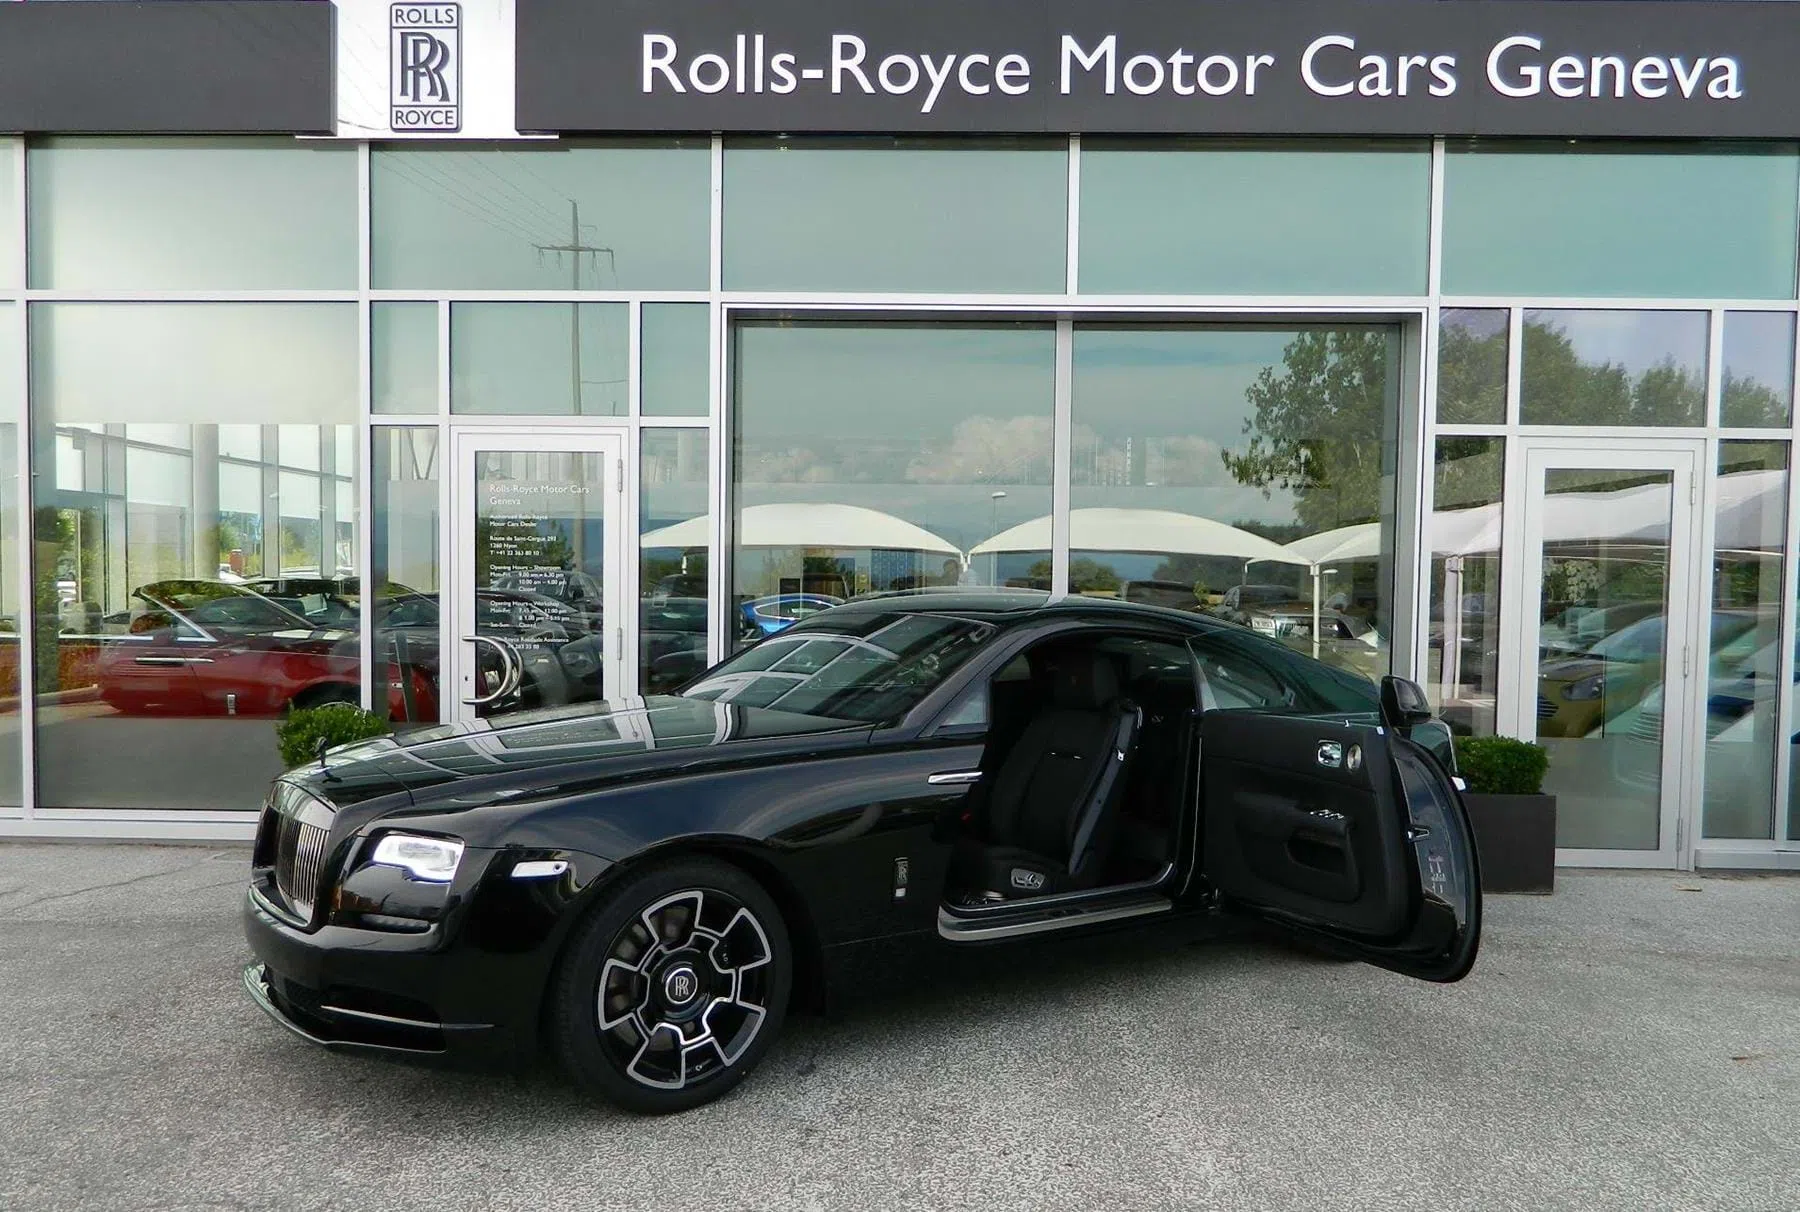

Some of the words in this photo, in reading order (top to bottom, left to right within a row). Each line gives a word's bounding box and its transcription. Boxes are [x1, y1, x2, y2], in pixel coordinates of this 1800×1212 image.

[395, 8, 454, 24] ROLLS
[400, 31, 450, 102] RR
[642, 33, 1030, 113] Rolls-Royce
[1060, 35, 1274, 96] Motor
[1300, 35, 1457, 97] Cars
[1486, 35, 1743, 98] Geneva
[395, 110, 454, 125] ROYCE
[490, 484, 539, 494] Rolls-Royce
[541, 485, 568, 493] Motor
[570, 484, 590, 493] Cars
[490, 496, 521, 505] Geneva
